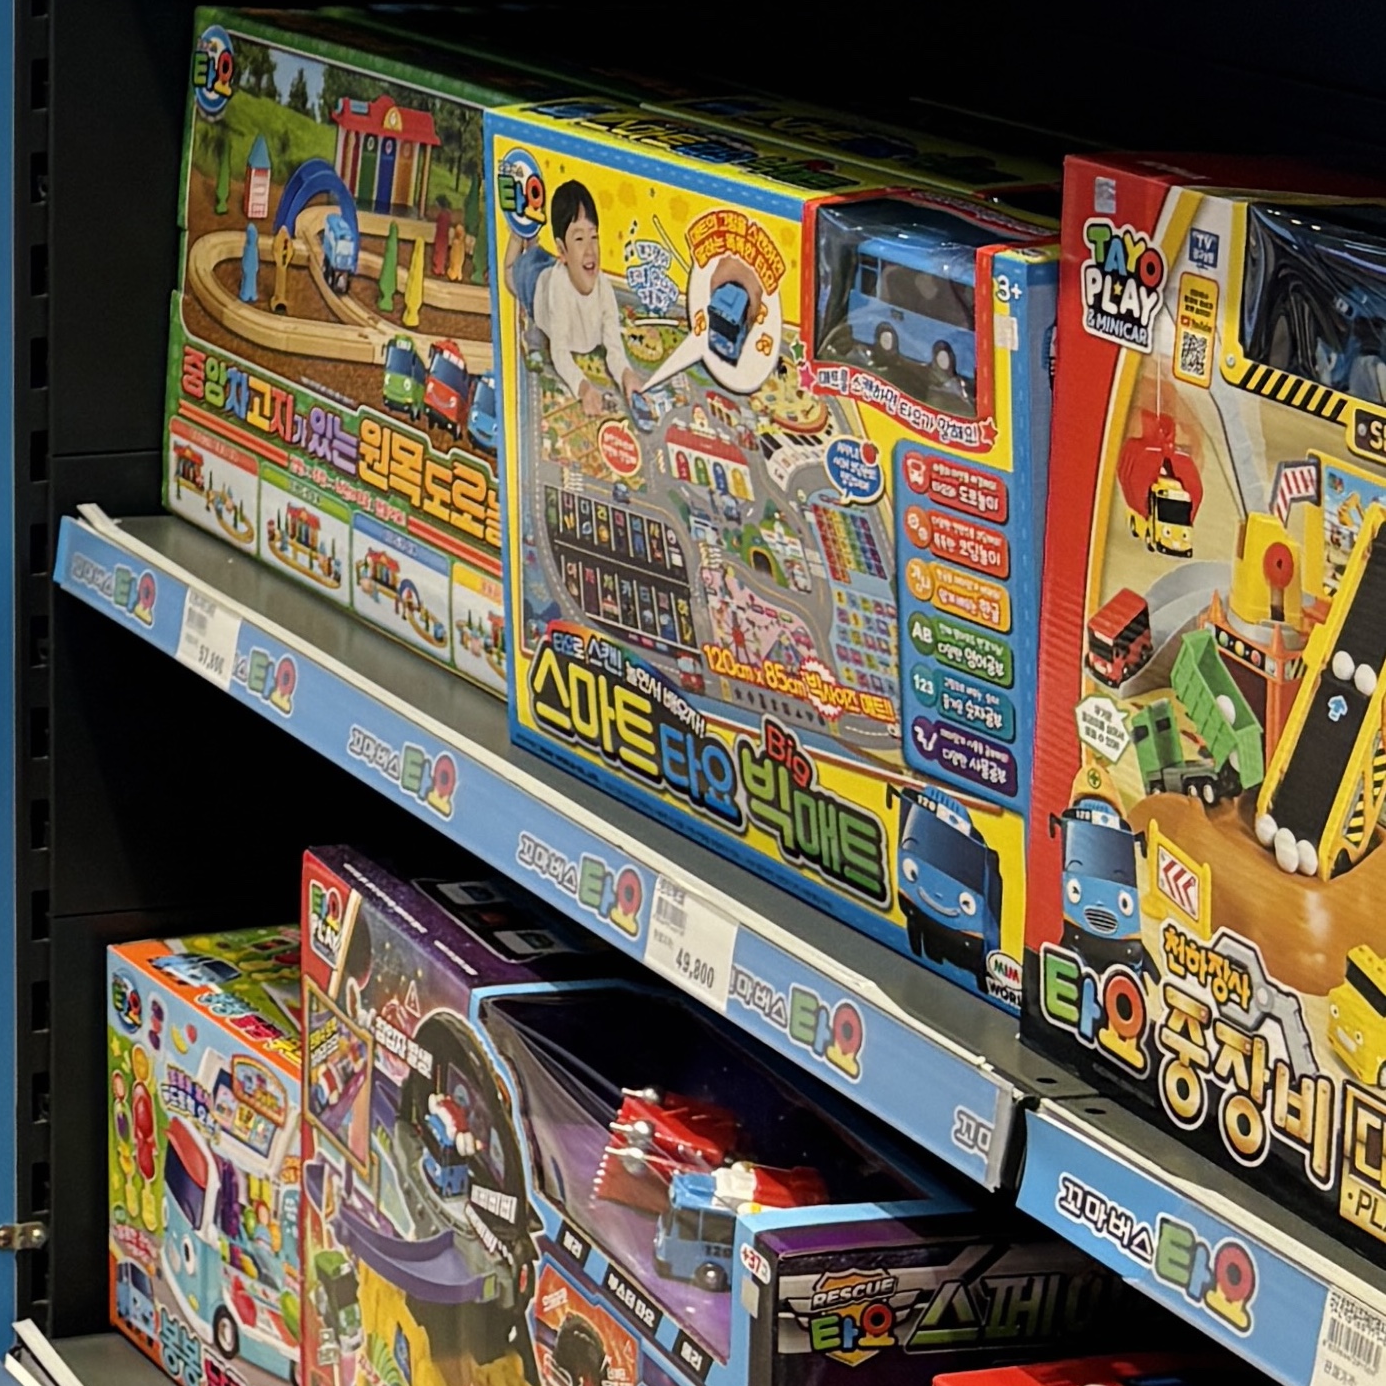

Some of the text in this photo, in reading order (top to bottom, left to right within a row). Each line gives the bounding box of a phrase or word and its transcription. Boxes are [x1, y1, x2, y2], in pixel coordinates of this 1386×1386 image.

[191, 52, 235, 99] 타요
[496, 173, 549, 224] 타요
[1086, 222, 1165, 288] TAYO
[1195, 233, 1213, 250] TV
[993, 274, 1023, 303] 3+
[1084, 265, 1159, 327] PLAY
[1095, 312, 1150, 346] MINICAR
[308, 405, 359, 475] 있는
[113, 564, 158, 628] 타요
[551, 632, 586, 659] 타요로
[911, 622, 933, 645] AB
[247, 646, 297, 718] 타요
[702, 643, 751, 681] 120cm
[764, 660, 807, 698] 85cm
[912, 674, 934, 695] 123
[533, 648, 741, 823] 스마트 타요
[765, 722, 811, 789] Big
[400, 740, 459, 822] 타요
[740, 745, 889, 903] 빅매트
[310, 878, 342, 927] 타요
[577, 853, 644, 940] 타요
[674, 947, 715, 991] 49,800
[1162, 924, 1253, 1013] 천하장사
[787, 980, 865, 1082] 타요
[1043, 945, 1146, 1072] 타요
[1160, 983, 1335, 1185] 중장비
[1058, 1174, 1258, 1337] 꼬마버스 타요
[812, 1276, 898, 1309] RESCUE
[810, 1304, 897, 1352] 타요
